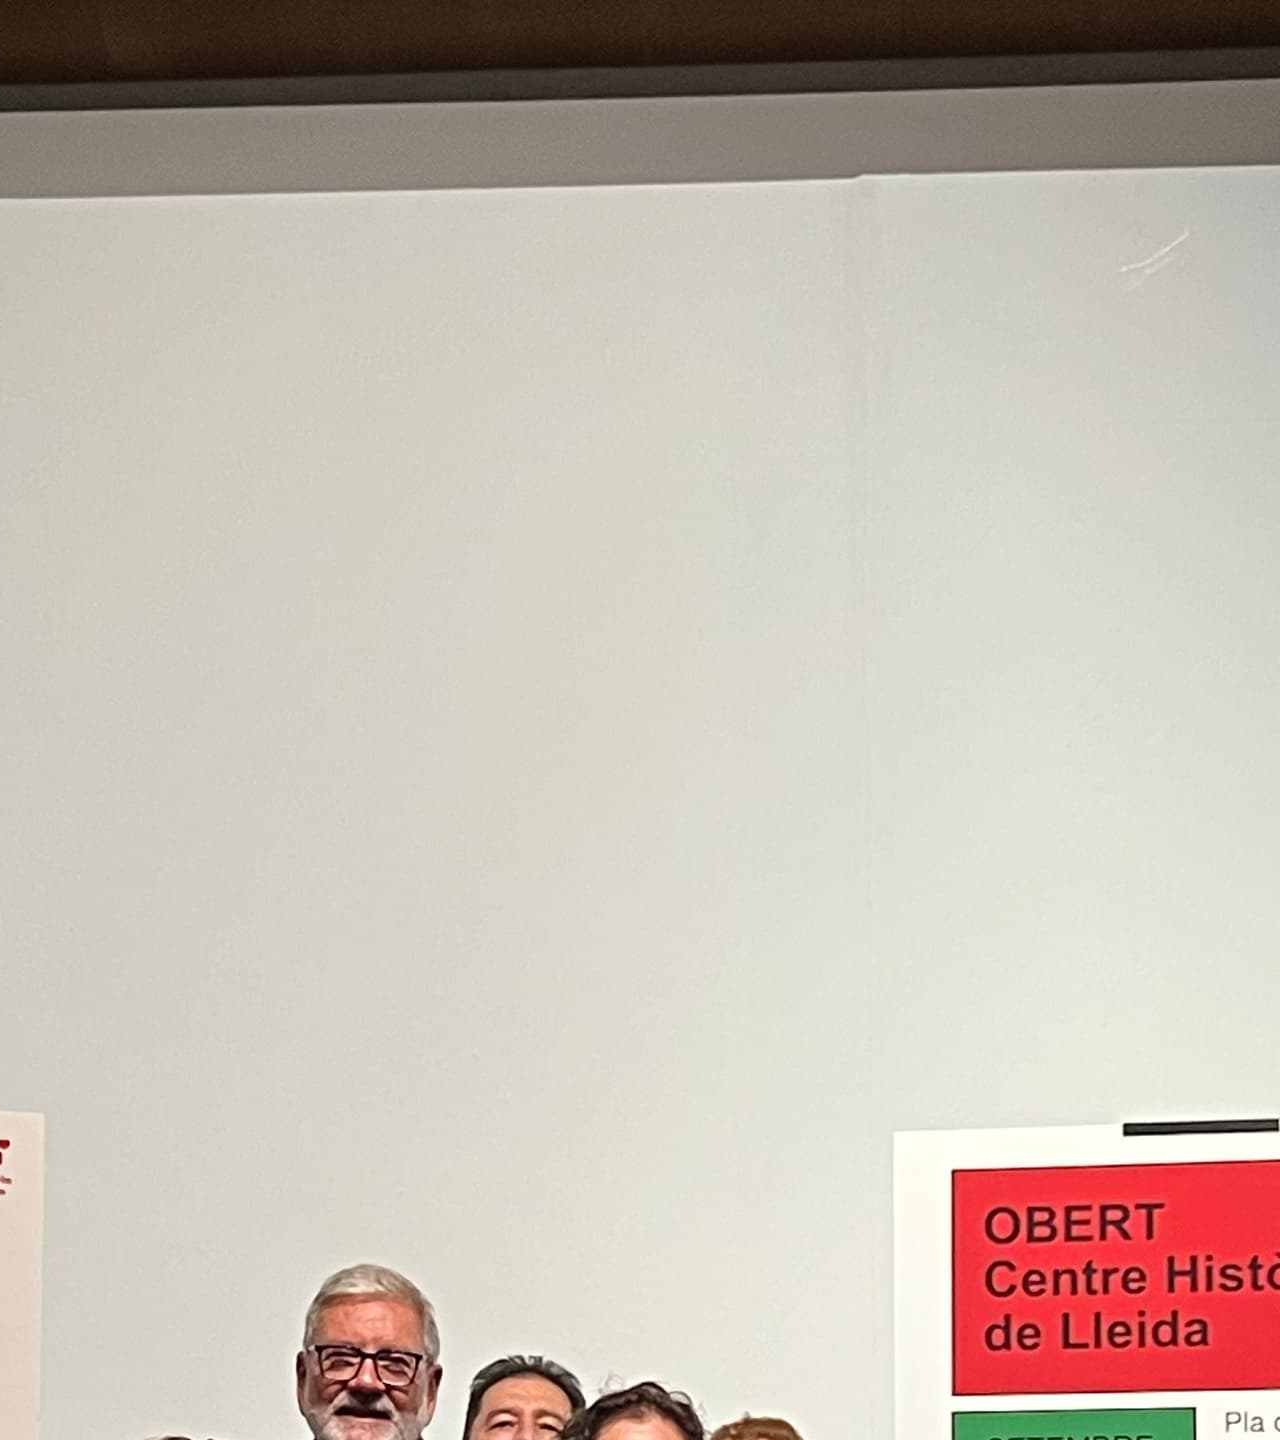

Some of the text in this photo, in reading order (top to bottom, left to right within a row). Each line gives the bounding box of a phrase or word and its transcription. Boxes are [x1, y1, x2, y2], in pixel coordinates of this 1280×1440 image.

[984, 1202, 1165, 1245] OBERT
[984, 1259, 1147, 1298] Centre
[984, 1309, 1210, 1351] de Lleida
[1225, 1411, 1266, 1433] Pla
